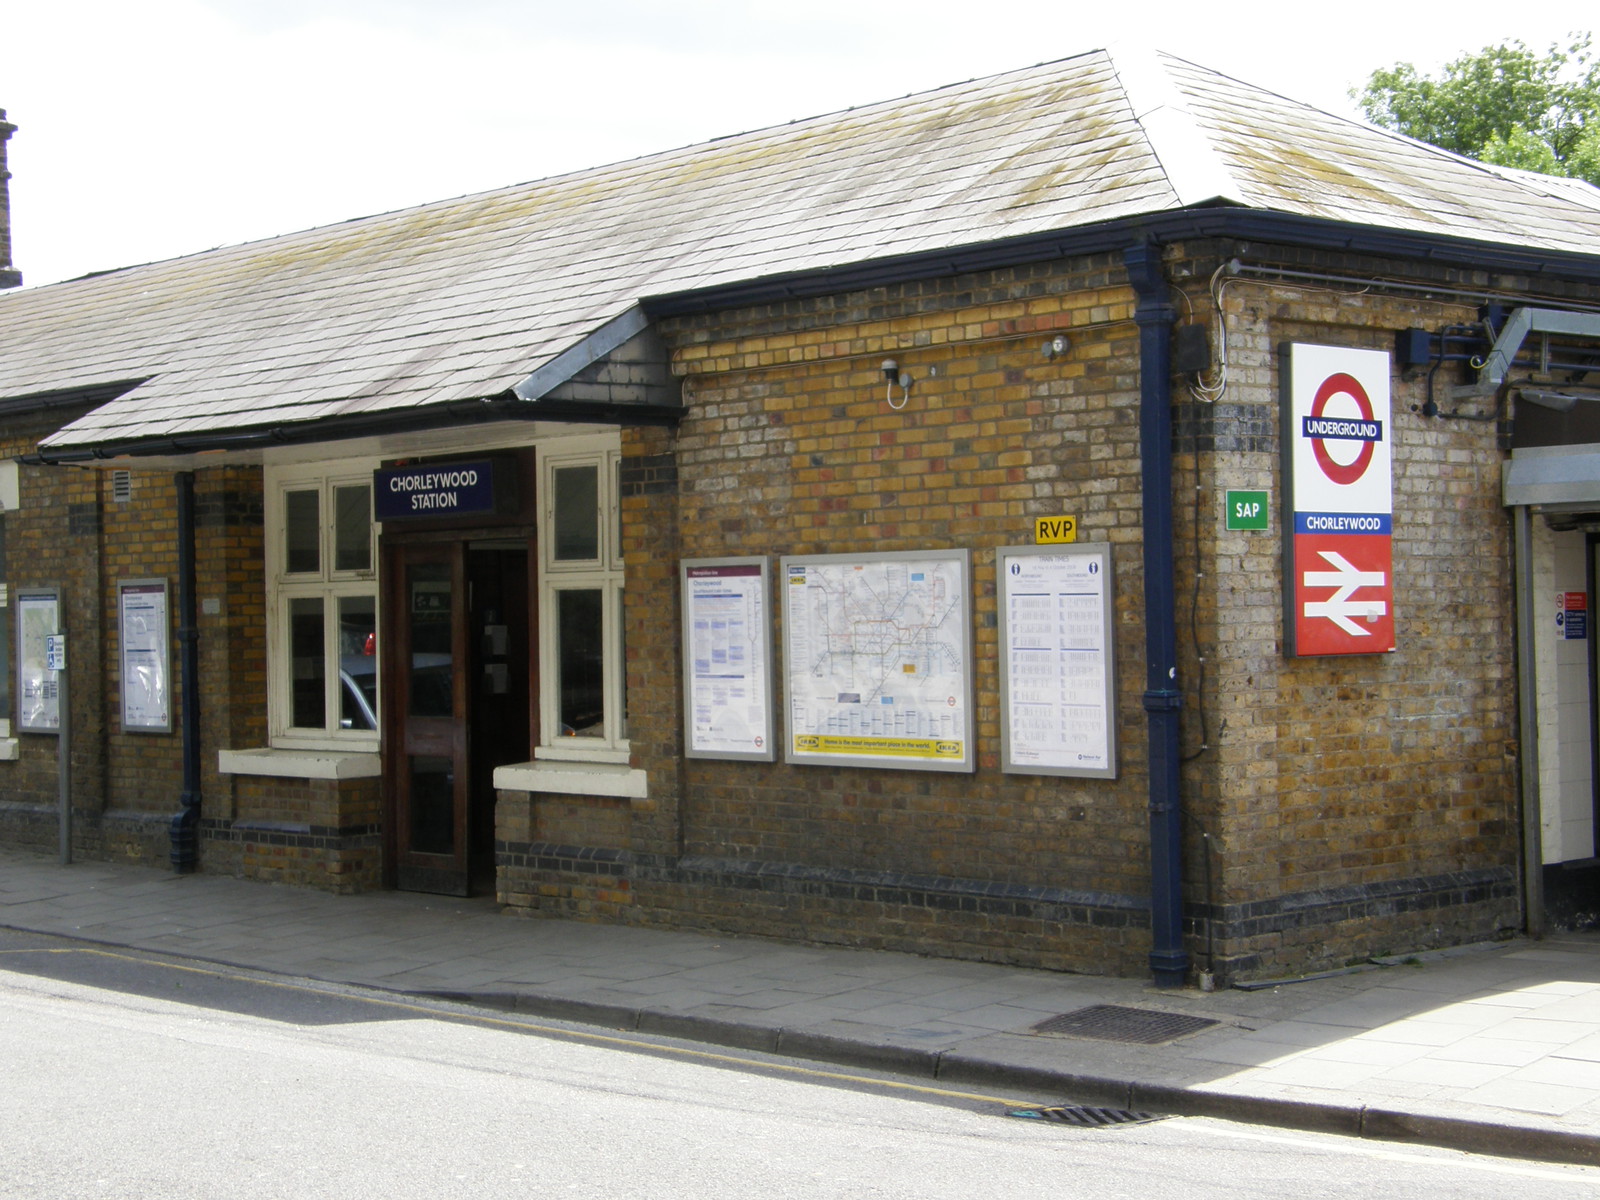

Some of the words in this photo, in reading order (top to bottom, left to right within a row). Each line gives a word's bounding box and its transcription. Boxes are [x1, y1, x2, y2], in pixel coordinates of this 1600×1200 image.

[1307, 420, 1377, 437] UNDERGROUND
[390, 470, 478, 492] CHORLEYWOOD
[411, 491, 457, 510] STATION
[1236, 502, 1260, 518] SAP
[1040, 520, 1073, 538] RVP
[1306, 516, 1381, 531] CHORLEYWOOD
